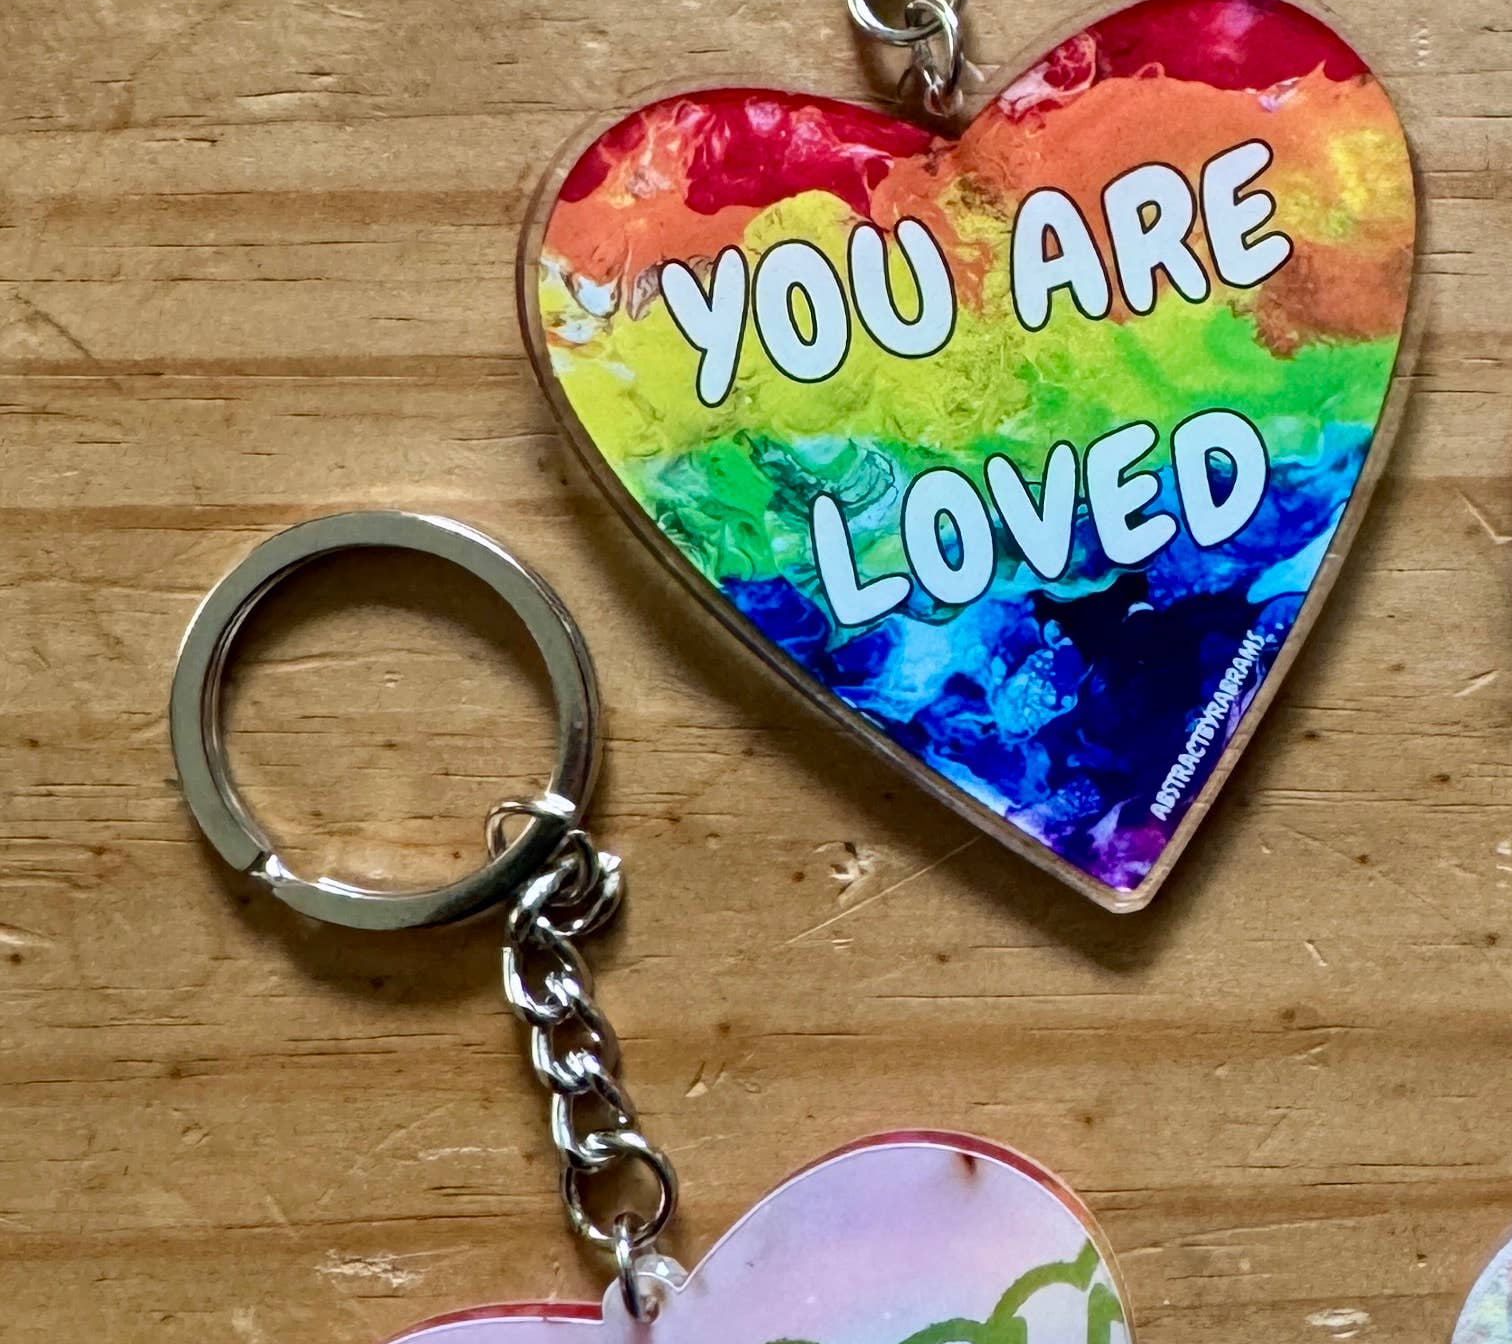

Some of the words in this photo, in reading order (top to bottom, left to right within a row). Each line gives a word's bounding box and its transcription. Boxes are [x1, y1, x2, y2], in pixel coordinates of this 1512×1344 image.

[660, 216, 957, 408] YOU
[1009, 138, 1293, 333] ARE
[811, 407, 1271, 628] LOVED
[1150, 629, 1265, 821] ABSTRACTBYRABRAMS
